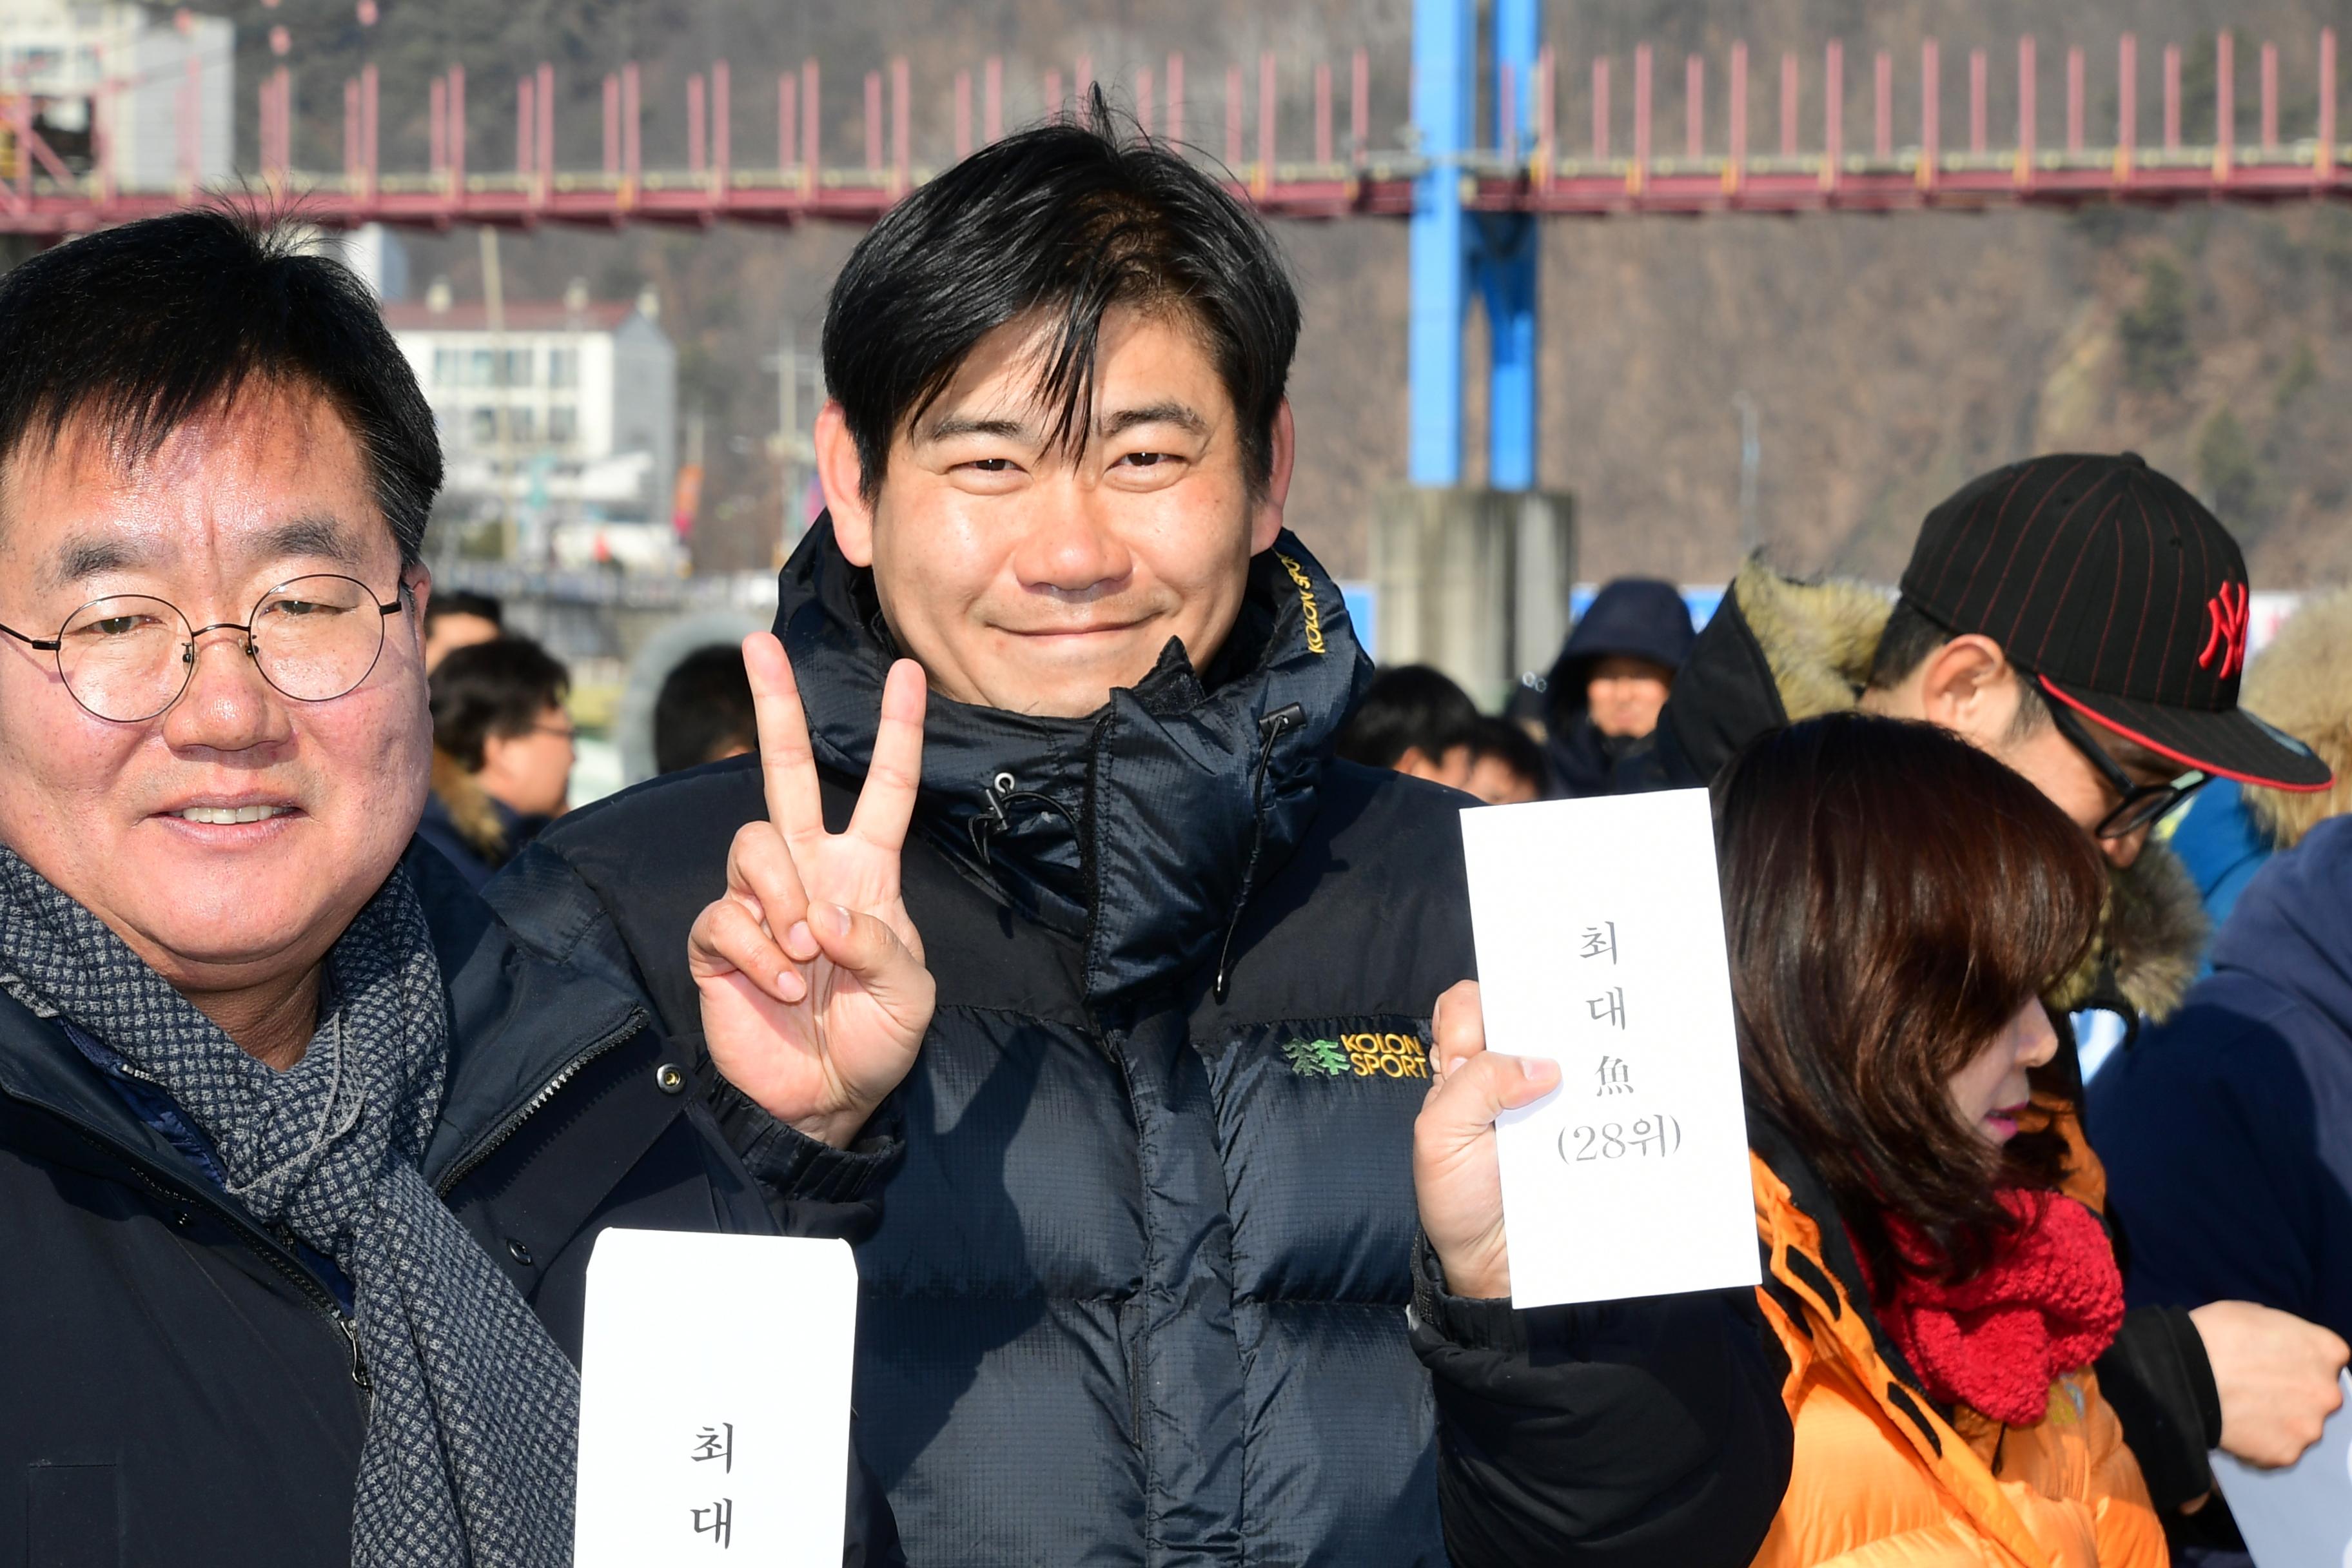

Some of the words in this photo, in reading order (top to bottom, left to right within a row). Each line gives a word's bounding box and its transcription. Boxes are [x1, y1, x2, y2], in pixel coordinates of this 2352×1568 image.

[1279, 554, 1311, 589] SPO
[1299, 588, 1326, 653] KOLON
[2199, 580, 2250, 680] NY
[1340, 1032, 1425, 1056] KOLON
[1349, 1052, 1428, 1079] SPORT
[1557, 1114, 1681, 1165] (28위)
